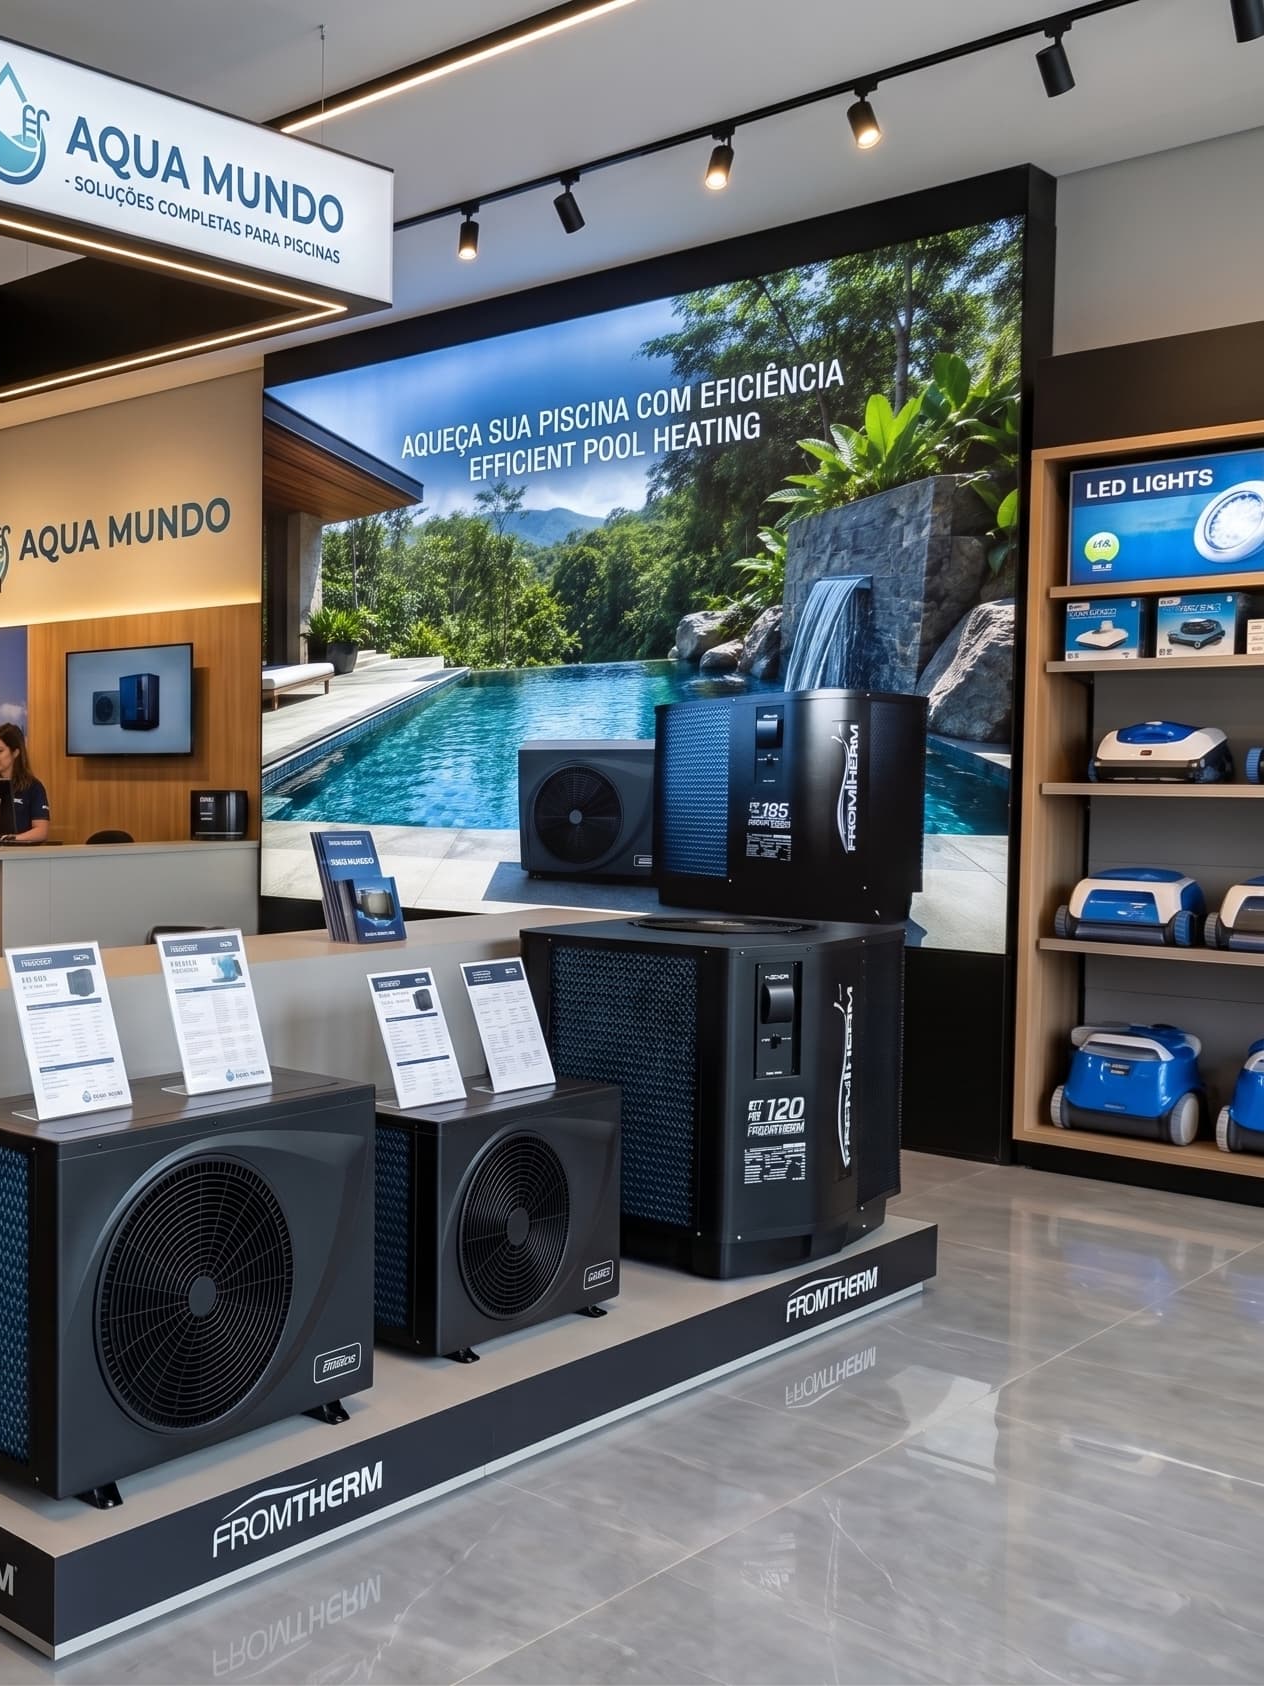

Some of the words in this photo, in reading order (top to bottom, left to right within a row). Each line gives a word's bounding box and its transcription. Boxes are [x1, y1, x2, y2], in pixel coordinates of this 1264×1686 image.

[66, 115, 191, 190] AQUA
[203, 155, 344, 233] MUNDO
[158, 200, 241, 236] COMPLETAS
[245, 223, 281, 248] PARA
[284, 235, 340, 264] PISCINAS
[401, 424, 483, 460] AQUEÇA
[489, 413, 532, 446] SUA
[539, 396, 630, 437] PISCINA
[636, 385, 691, 419] COM
[700, 358, 845, 409] EFICIÊNCIA
[469, 441, 577, 482] EFFICIENT
[583, 431, 645, 466] POOL
[653, 411, 762, 455] HEATING
[1086, 479, 1126, 499] LED
[1132, 468, 1214, 494] LIGHTS
[19, 519, 100, 563] AQUA
[109, 497, 231, 548] MUNDO
[762, 802, 789, 818] 185
[767, 1096, 805, 1121] 120
[786, 1266, 878, 1323] FROMTHERM
[213, 1460, 383, 1558] FROMTHERM
